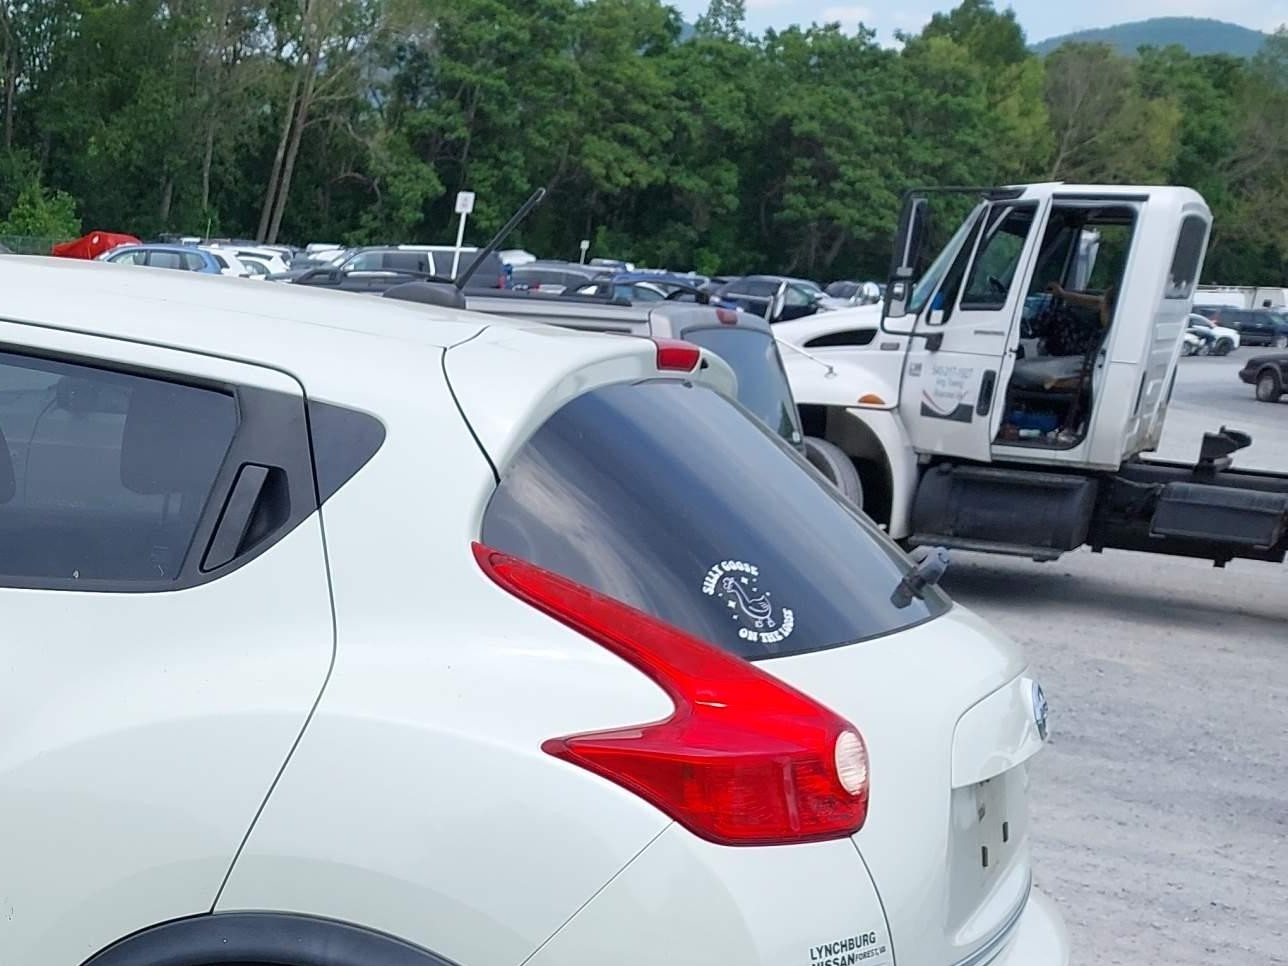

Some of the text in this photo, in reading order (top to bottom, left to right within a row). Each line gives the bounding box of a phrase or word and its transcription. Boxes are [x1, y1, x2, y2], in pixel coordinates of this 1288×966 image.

[702, 560, 759, 595] SILLY GOOSE
[738, 628, 758, 642] ON
[759, 630, 784, 643] THE
[810, 931, 876, 961] LYNCHBURG
